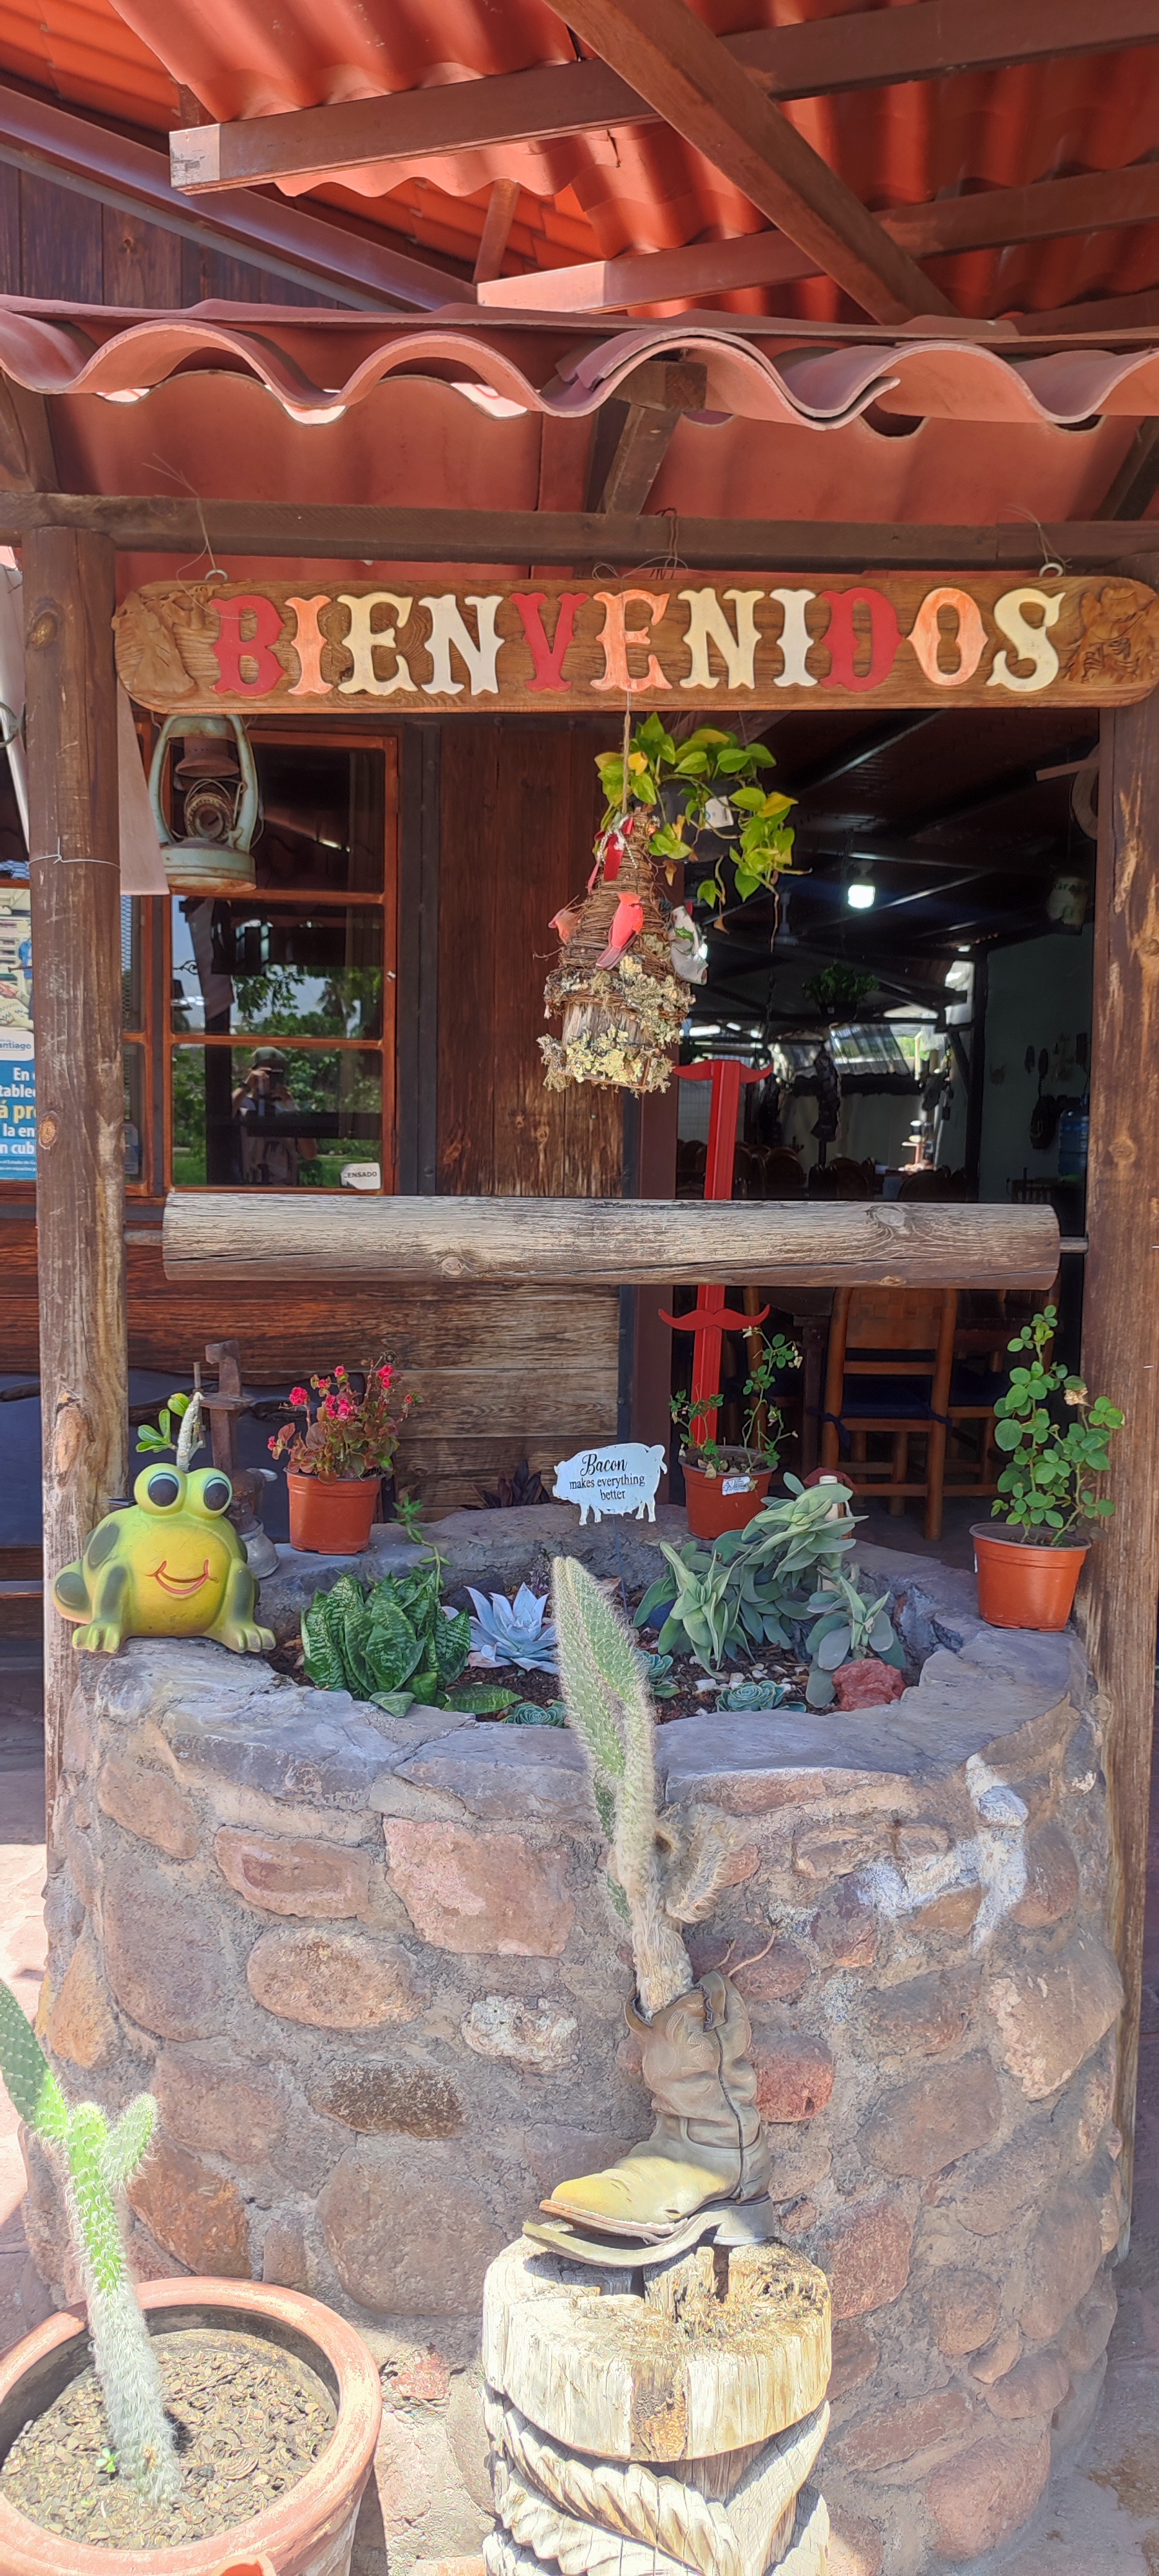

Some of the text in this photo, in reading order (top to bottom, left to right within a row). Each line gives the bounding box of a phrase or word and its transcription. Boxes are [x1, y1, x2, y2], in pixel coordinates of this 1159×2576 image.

[212, 587, 1066, 696] BIENVENIDOS
[14, 1066, 30, 1081] En
[3, 1123, 35, 1137] la en
[11, 1141, 35, 1154] cub
[580, 1454, 628, 1477] Bacon
[569, 1473, 645, 1490] makes everything
[599, 1489, 626, 1501] better
